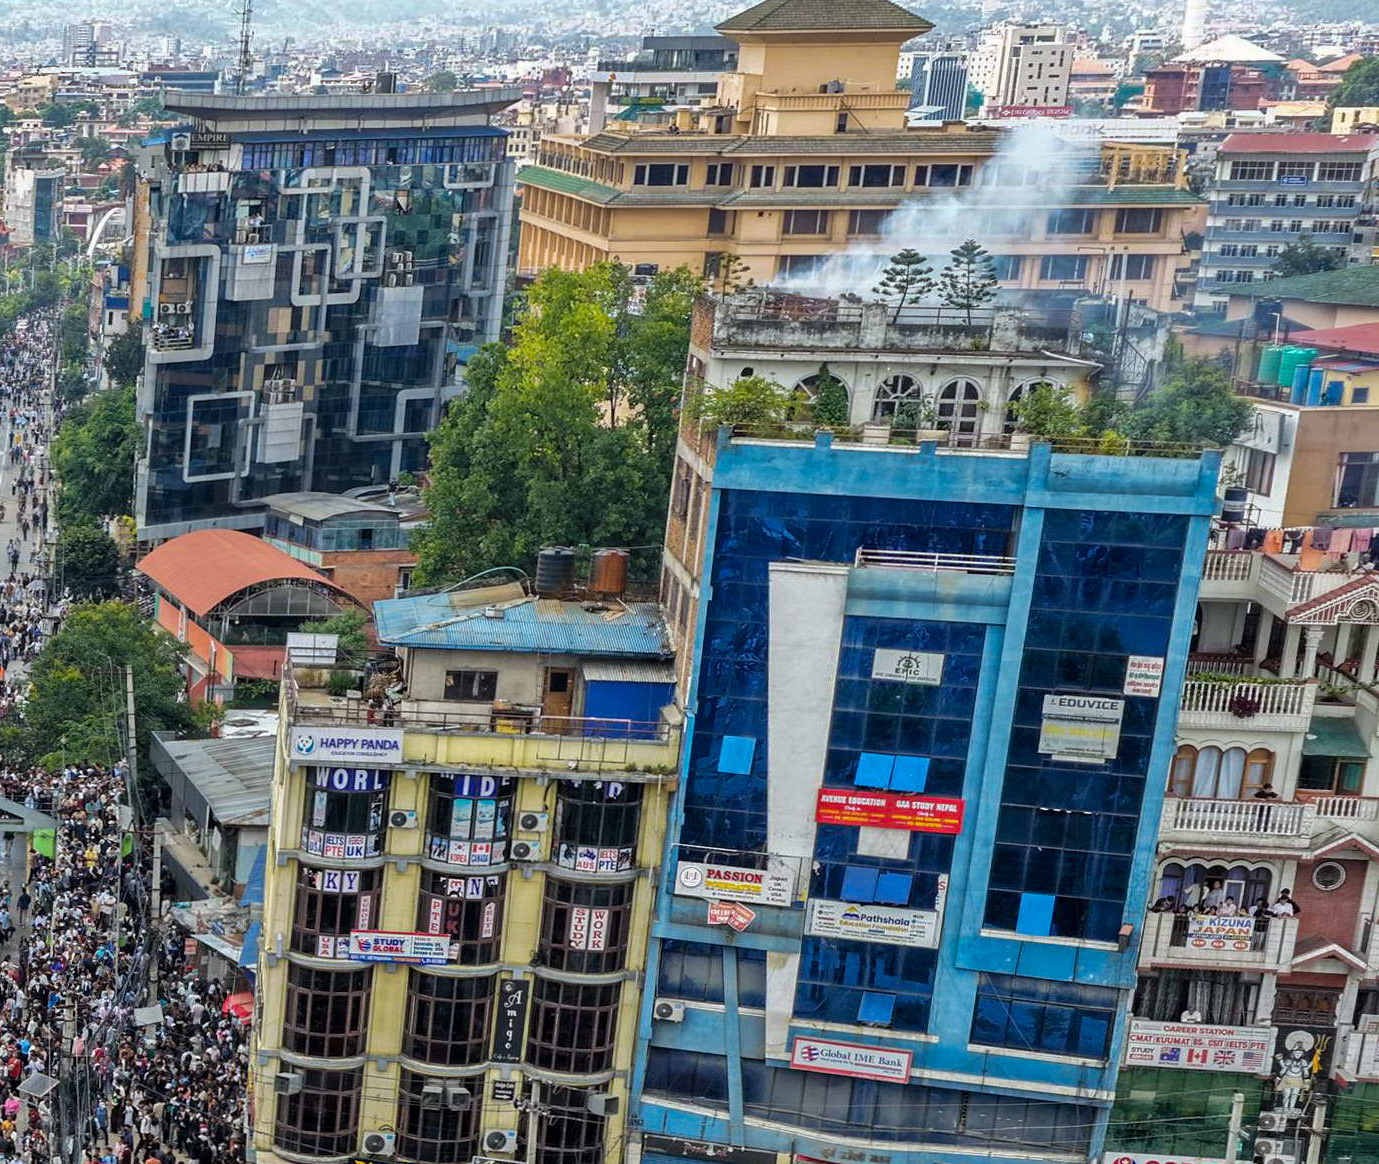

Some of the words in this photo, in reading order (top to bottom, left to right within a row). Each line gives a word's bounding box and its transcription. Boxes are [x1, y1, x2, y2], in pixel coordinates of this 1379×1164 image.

[192, 134, 230, 142] EMPIRE
[895, 668, 920, 676] EPIC
[1058, 698, 1119, 710] EDUVICE
[320, 738, 358, 749] HAPPY
[360, 739, 400, 751] PANDA
[821, 794, 847, 804] AVENUE
[848, 796, 886, 807] EDUCATION
[912, 801, 934, 811] STUDY
[936, 804, 958, 813] NEPAL
[325, 836, 344, 845] IELTS
[325, 846, 344, 857] PTE
[346, 845, 363, 857] UK
[599, 850, 617, 859] IELTS
[449, 854, 468, 863] KOREA
[472, 854, 489, 863] CANADA
[577, 861, 594, 870] AUS
[599, 860, 616, 870] PTE
[707, 869, 764, 884] PASSION
[430, 901, 441, 933] PTE
[446, 903, 460, 934] UK
[860, 913, 910, 926] Pathshala
[1209, 918, 1252, 928] KIZUNA
[572, 908, 586, 949] STUDY
[592, 911, 606, 949] WORK
[839, 920, 872, 929] Education
[872, 923, 909, 933] Foundation
[1193, 926, 1250, 935] JAPAN
[321, 938, 331, 956] USA
[373, 938, 405, 946] STUDY
[373, 946, 405, 954] GLOBAL
[504, 990, 523, 1050] Amigo
[1163, 1025, 1198, 1034] CAREER
[1199, 1028, 1235, 1036] STATION
[1129, 1034, 1153, 1043] CMAT
[1155, 1036, 1191, 1045] KUUMAT
[1226, 1040, 1248, 1049] IELTS
[820, 1049, 851, 1060] Global
[854, 1054, 876, 1063] IME
[878, 1057, 903, 1067] Bank
